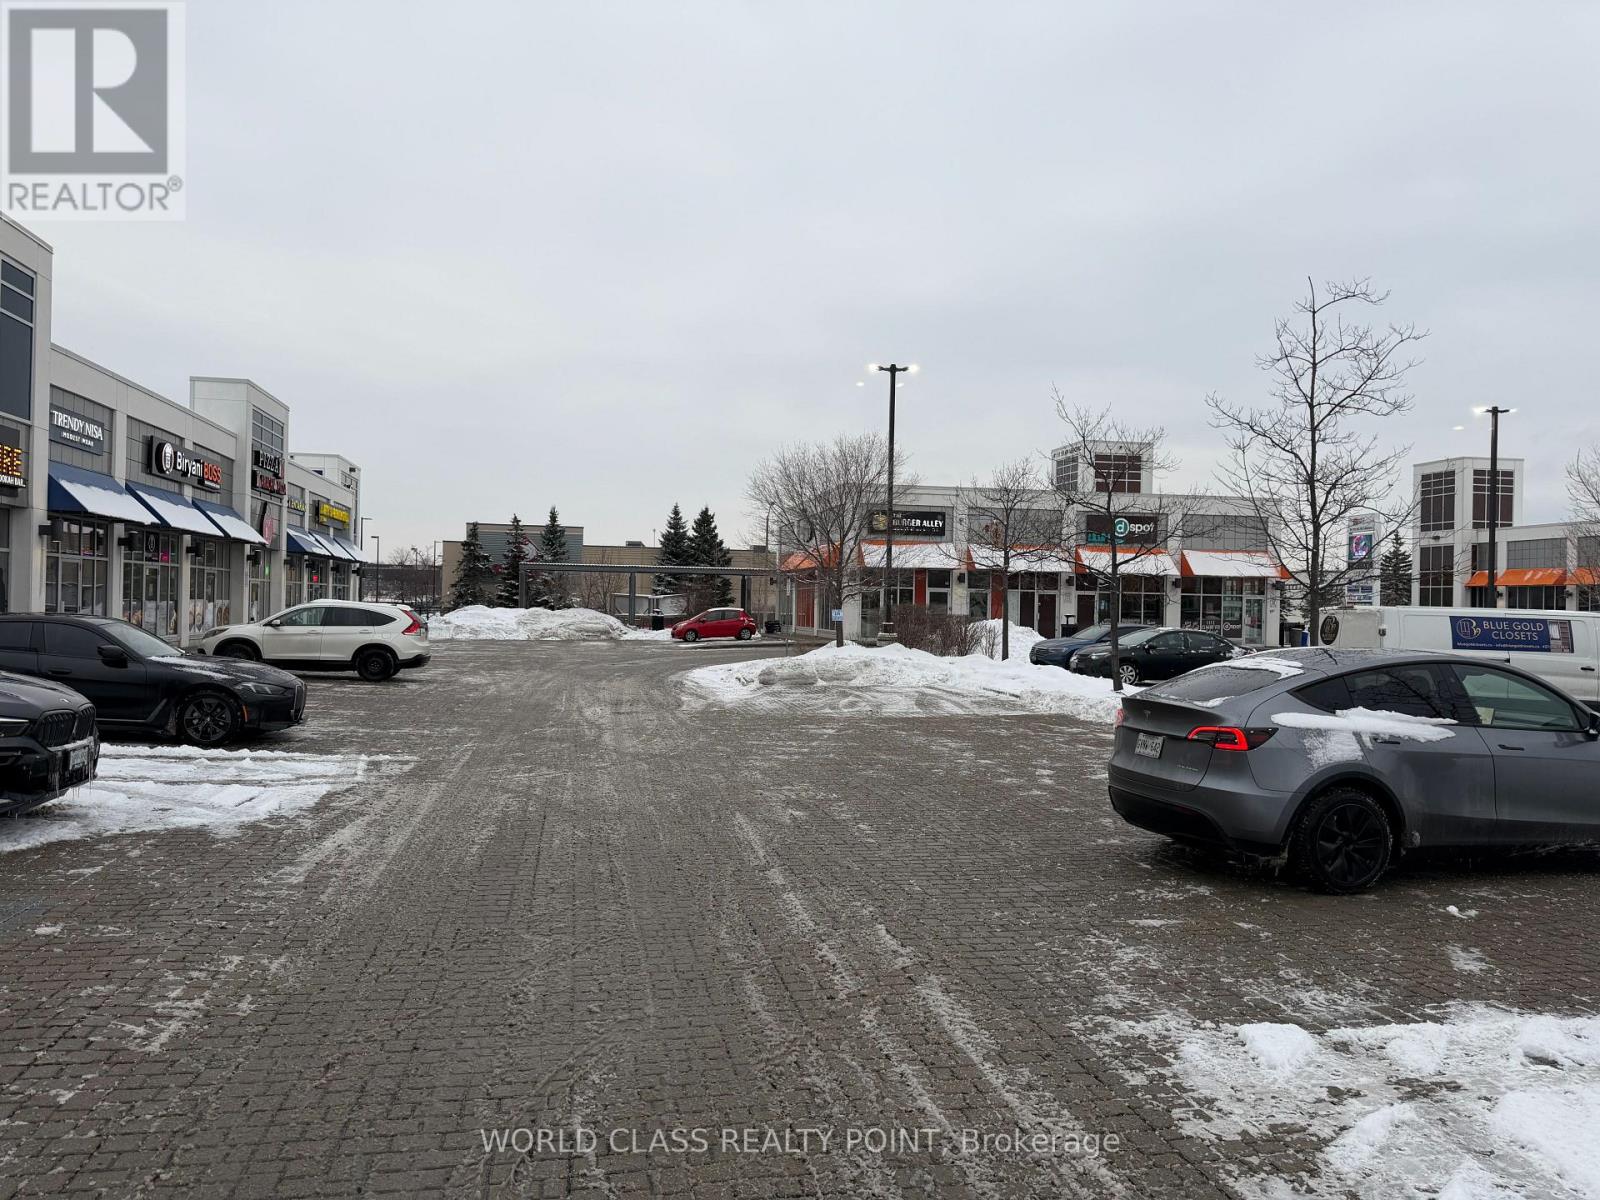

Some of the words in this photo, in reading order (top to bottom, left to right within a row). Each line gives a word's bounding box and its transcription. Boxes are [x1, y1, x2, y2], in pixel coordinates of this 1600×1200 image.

[52, 410, 84, 434] TRENDY
[85, 422, 103, 441] NISA
[176, 451, 203, 478] Biryani
[203, 461, 222, 484] BOSS
[922, 520, 944, 528] ALLEY
[1483, 621, 1510, 631] BLUE
[1512, 622, 1544, 631] GOLD
[1491, 631, 1539, 641] CLOSETS
